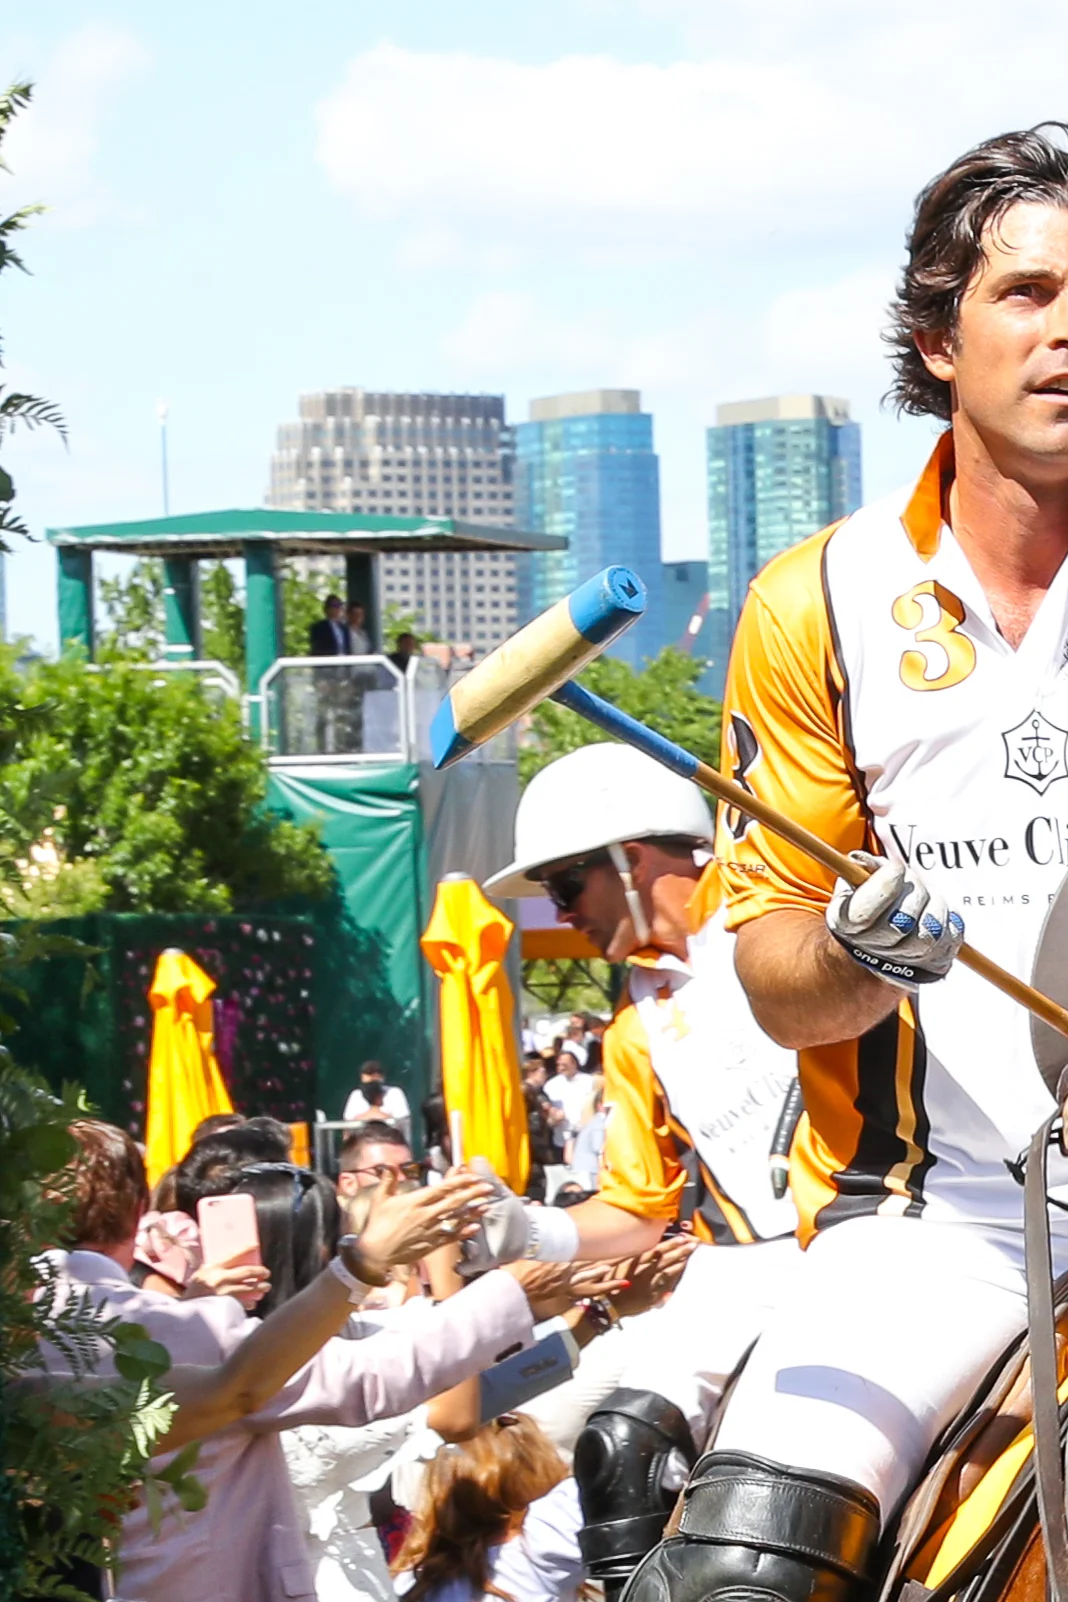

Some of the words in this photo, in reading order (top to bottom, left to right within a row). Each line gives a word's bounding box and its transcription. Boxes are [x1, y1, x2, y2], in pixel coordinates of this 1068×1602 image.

[890, 579, 977, 692] 3
[1017, 745, 1054, 763] VCP
[888, 822, 1010, 871] Veuve
[963, 893, 1030, 906] REIMS
[853, 948, 879, 965] ona
[881, 962, 914, 978] polo
